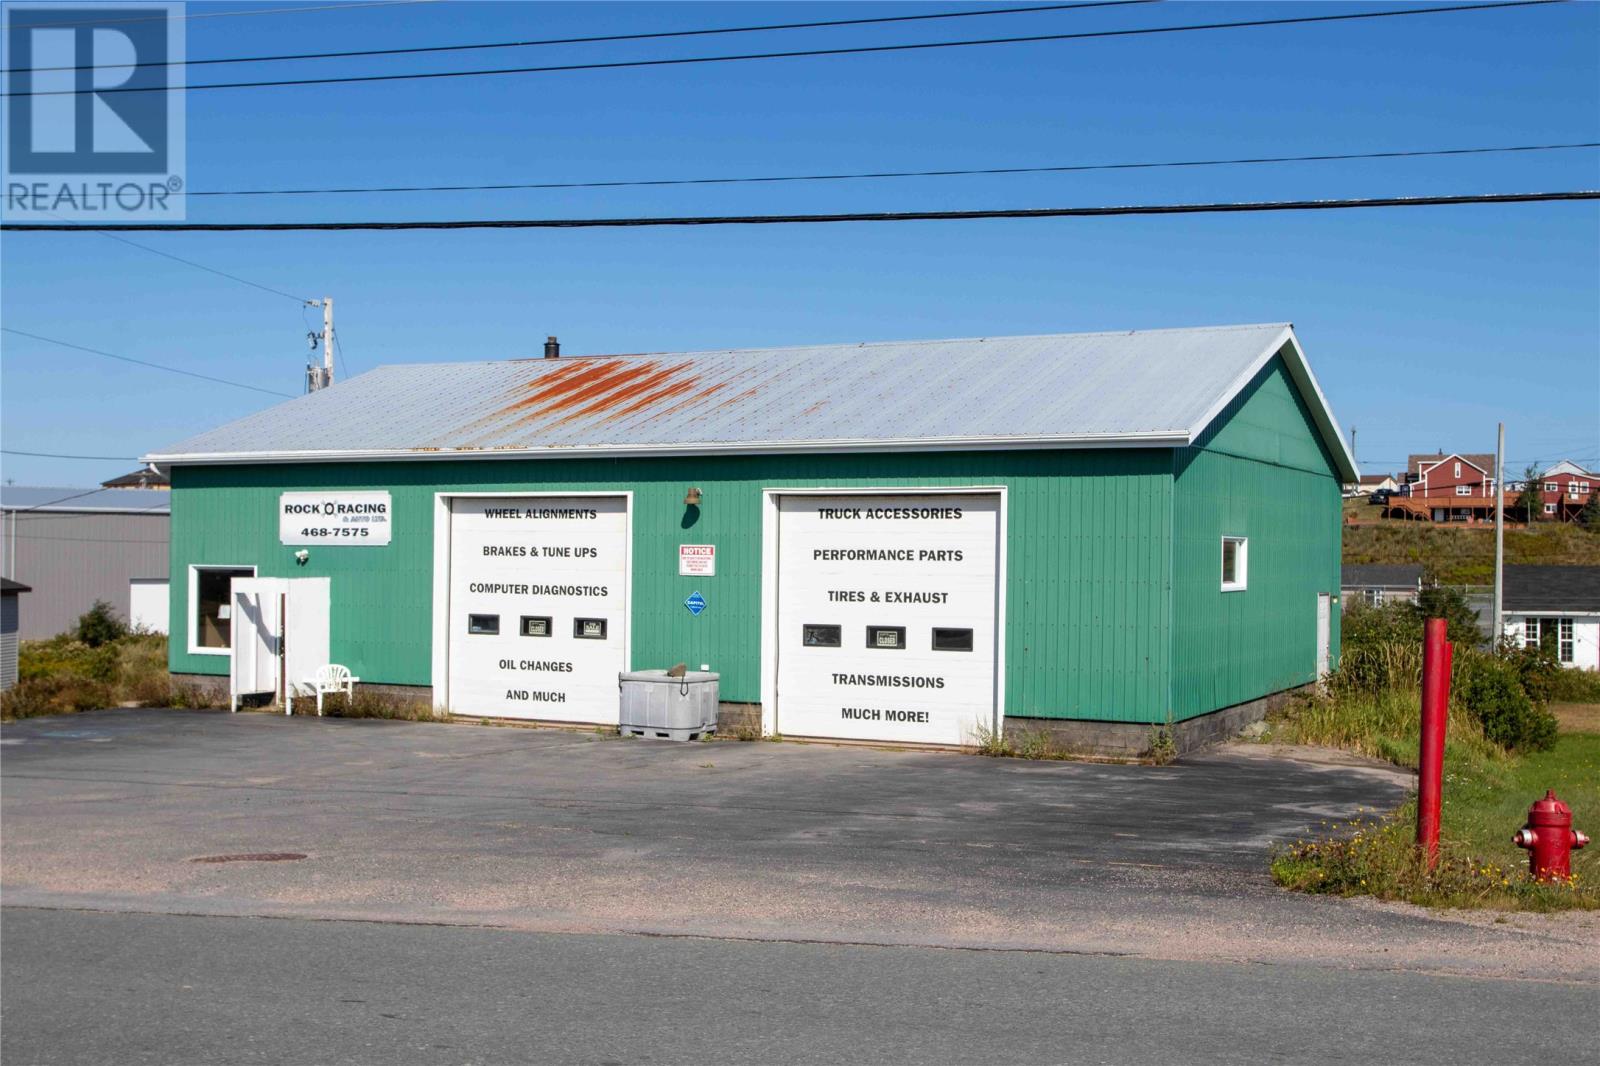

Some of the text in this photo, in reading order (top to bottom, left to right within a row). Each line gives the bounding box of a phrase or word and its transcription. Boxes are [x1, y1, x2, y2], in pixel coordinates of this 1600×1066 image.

[285, 505, 320, 513] ROCK
[337, 504, 386, 513] RACING
[484, 508, 597, 519] WHEEL ALIGNMENTS
[818, 508, 963, 519] TRUCK ACCESSORIES
[301, 528, 369, 536] 468-7575
[483, 546, 598, 558] BRAKES & TUNE UPS
[813, 550, 964, 561] PERFORMANCE PARTS
[469, 583, 608, 596] COMPUTER DIAGNOSTICS
[828, 590, 949, 603] TIRES & EXHAUST
[499, 659, 573, 672] OIL CHANGES
[832, 673, 944, 688] TRANSMISSIONS
[506, 690, 566, 703] AND MUCH
[841, 708, 929, 723] MUCH MORE!
